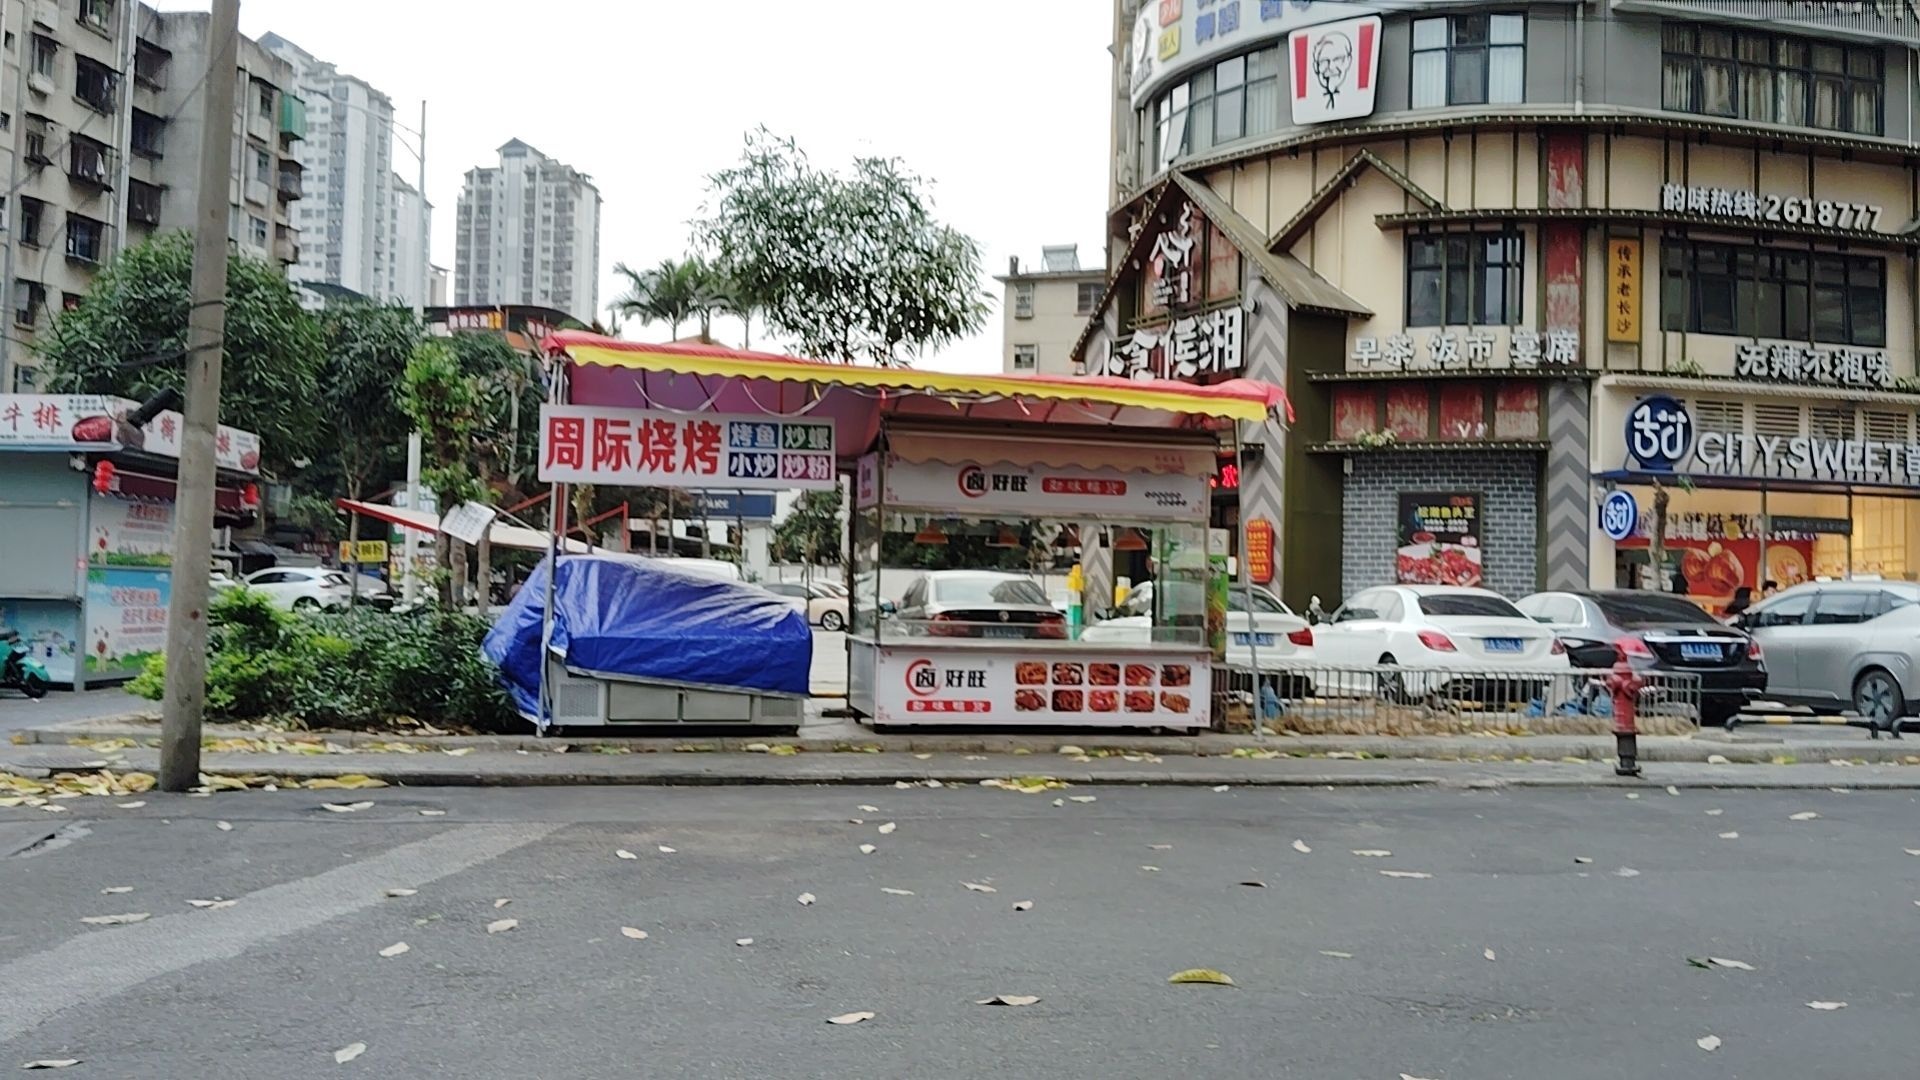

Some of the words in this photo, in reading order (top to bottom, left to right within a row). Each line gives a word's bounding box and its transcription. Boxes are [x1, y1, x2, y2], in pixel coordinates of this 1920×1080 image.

[1351, 335, 1415, 366] 早茶
[1428, 333, 1496, 363] 饭市
[1509, 331, 1579, 364] 宴席
[3, 401, 62, 433] 牛排
[546, 417, 722, 475] 周际烧烤
[731, 423, 777, 448] 烤鱼
[730, 454, 776, 477] 小炒
[783, 456, 830, 480] 炒粉
